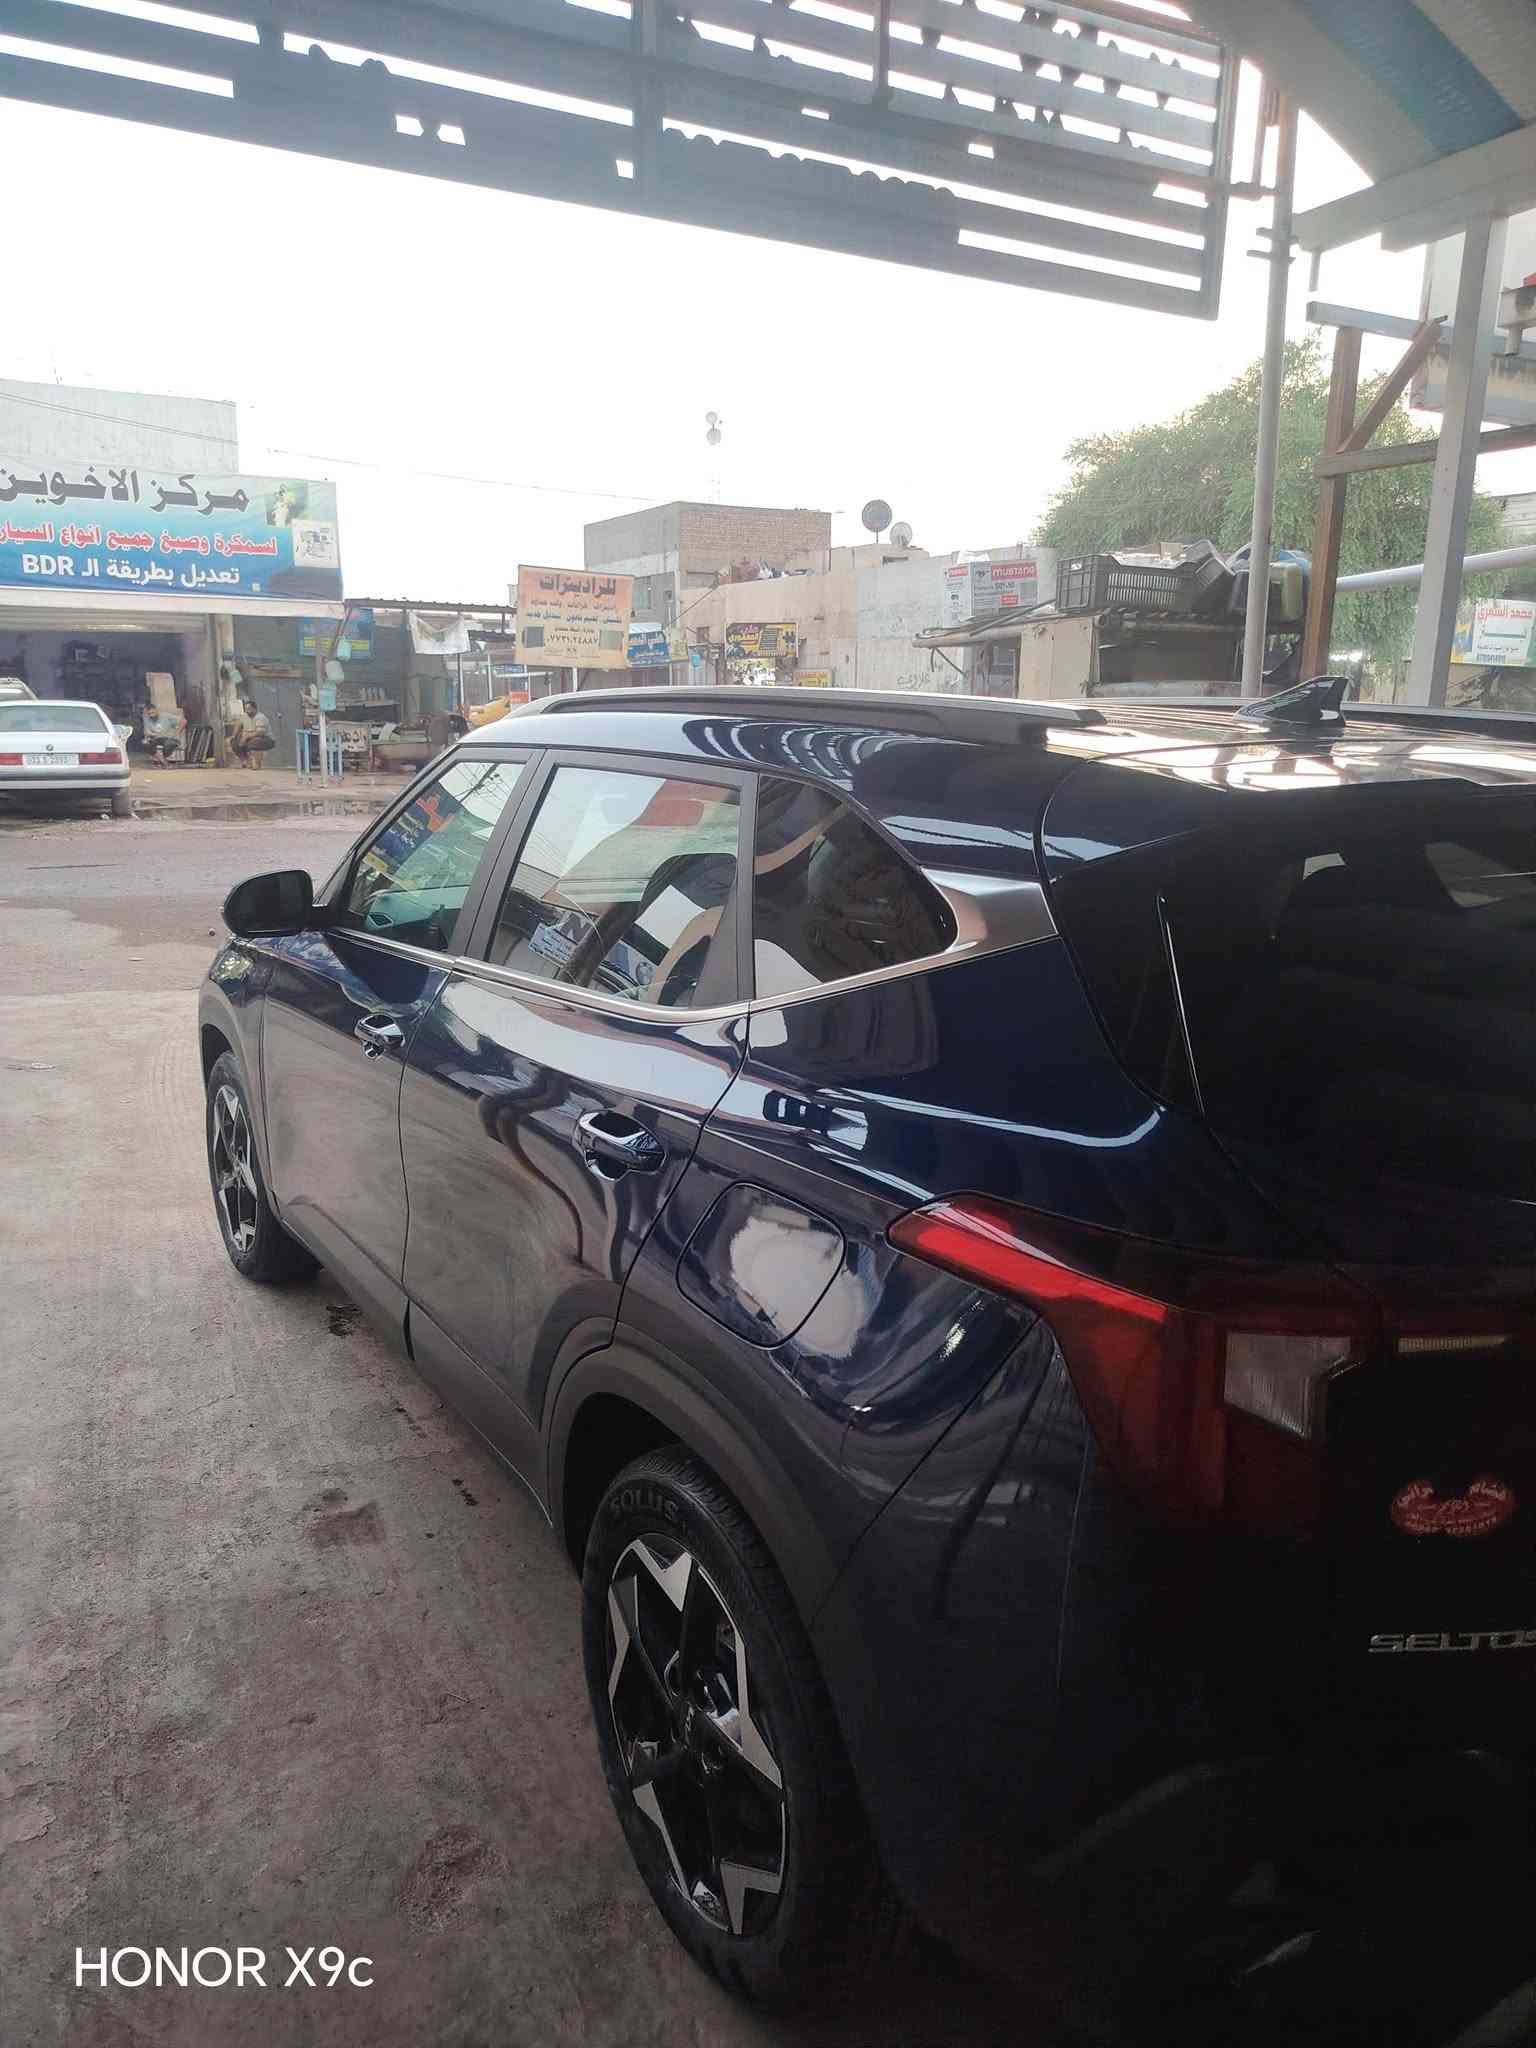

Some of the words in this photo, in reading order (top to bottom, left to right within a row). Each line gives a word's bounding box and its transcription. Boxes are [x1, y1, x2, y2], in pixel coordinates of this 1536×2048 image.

[150, 474, 250, 515] مركز
[107, 530, 154, 551] جميع
[160, 529, 209, 554] وصبغ
[22, 553, 74, 576] BDR
[107, 560, 174, 585] بطريقة
[181, 563, 240, 587] تعديل
